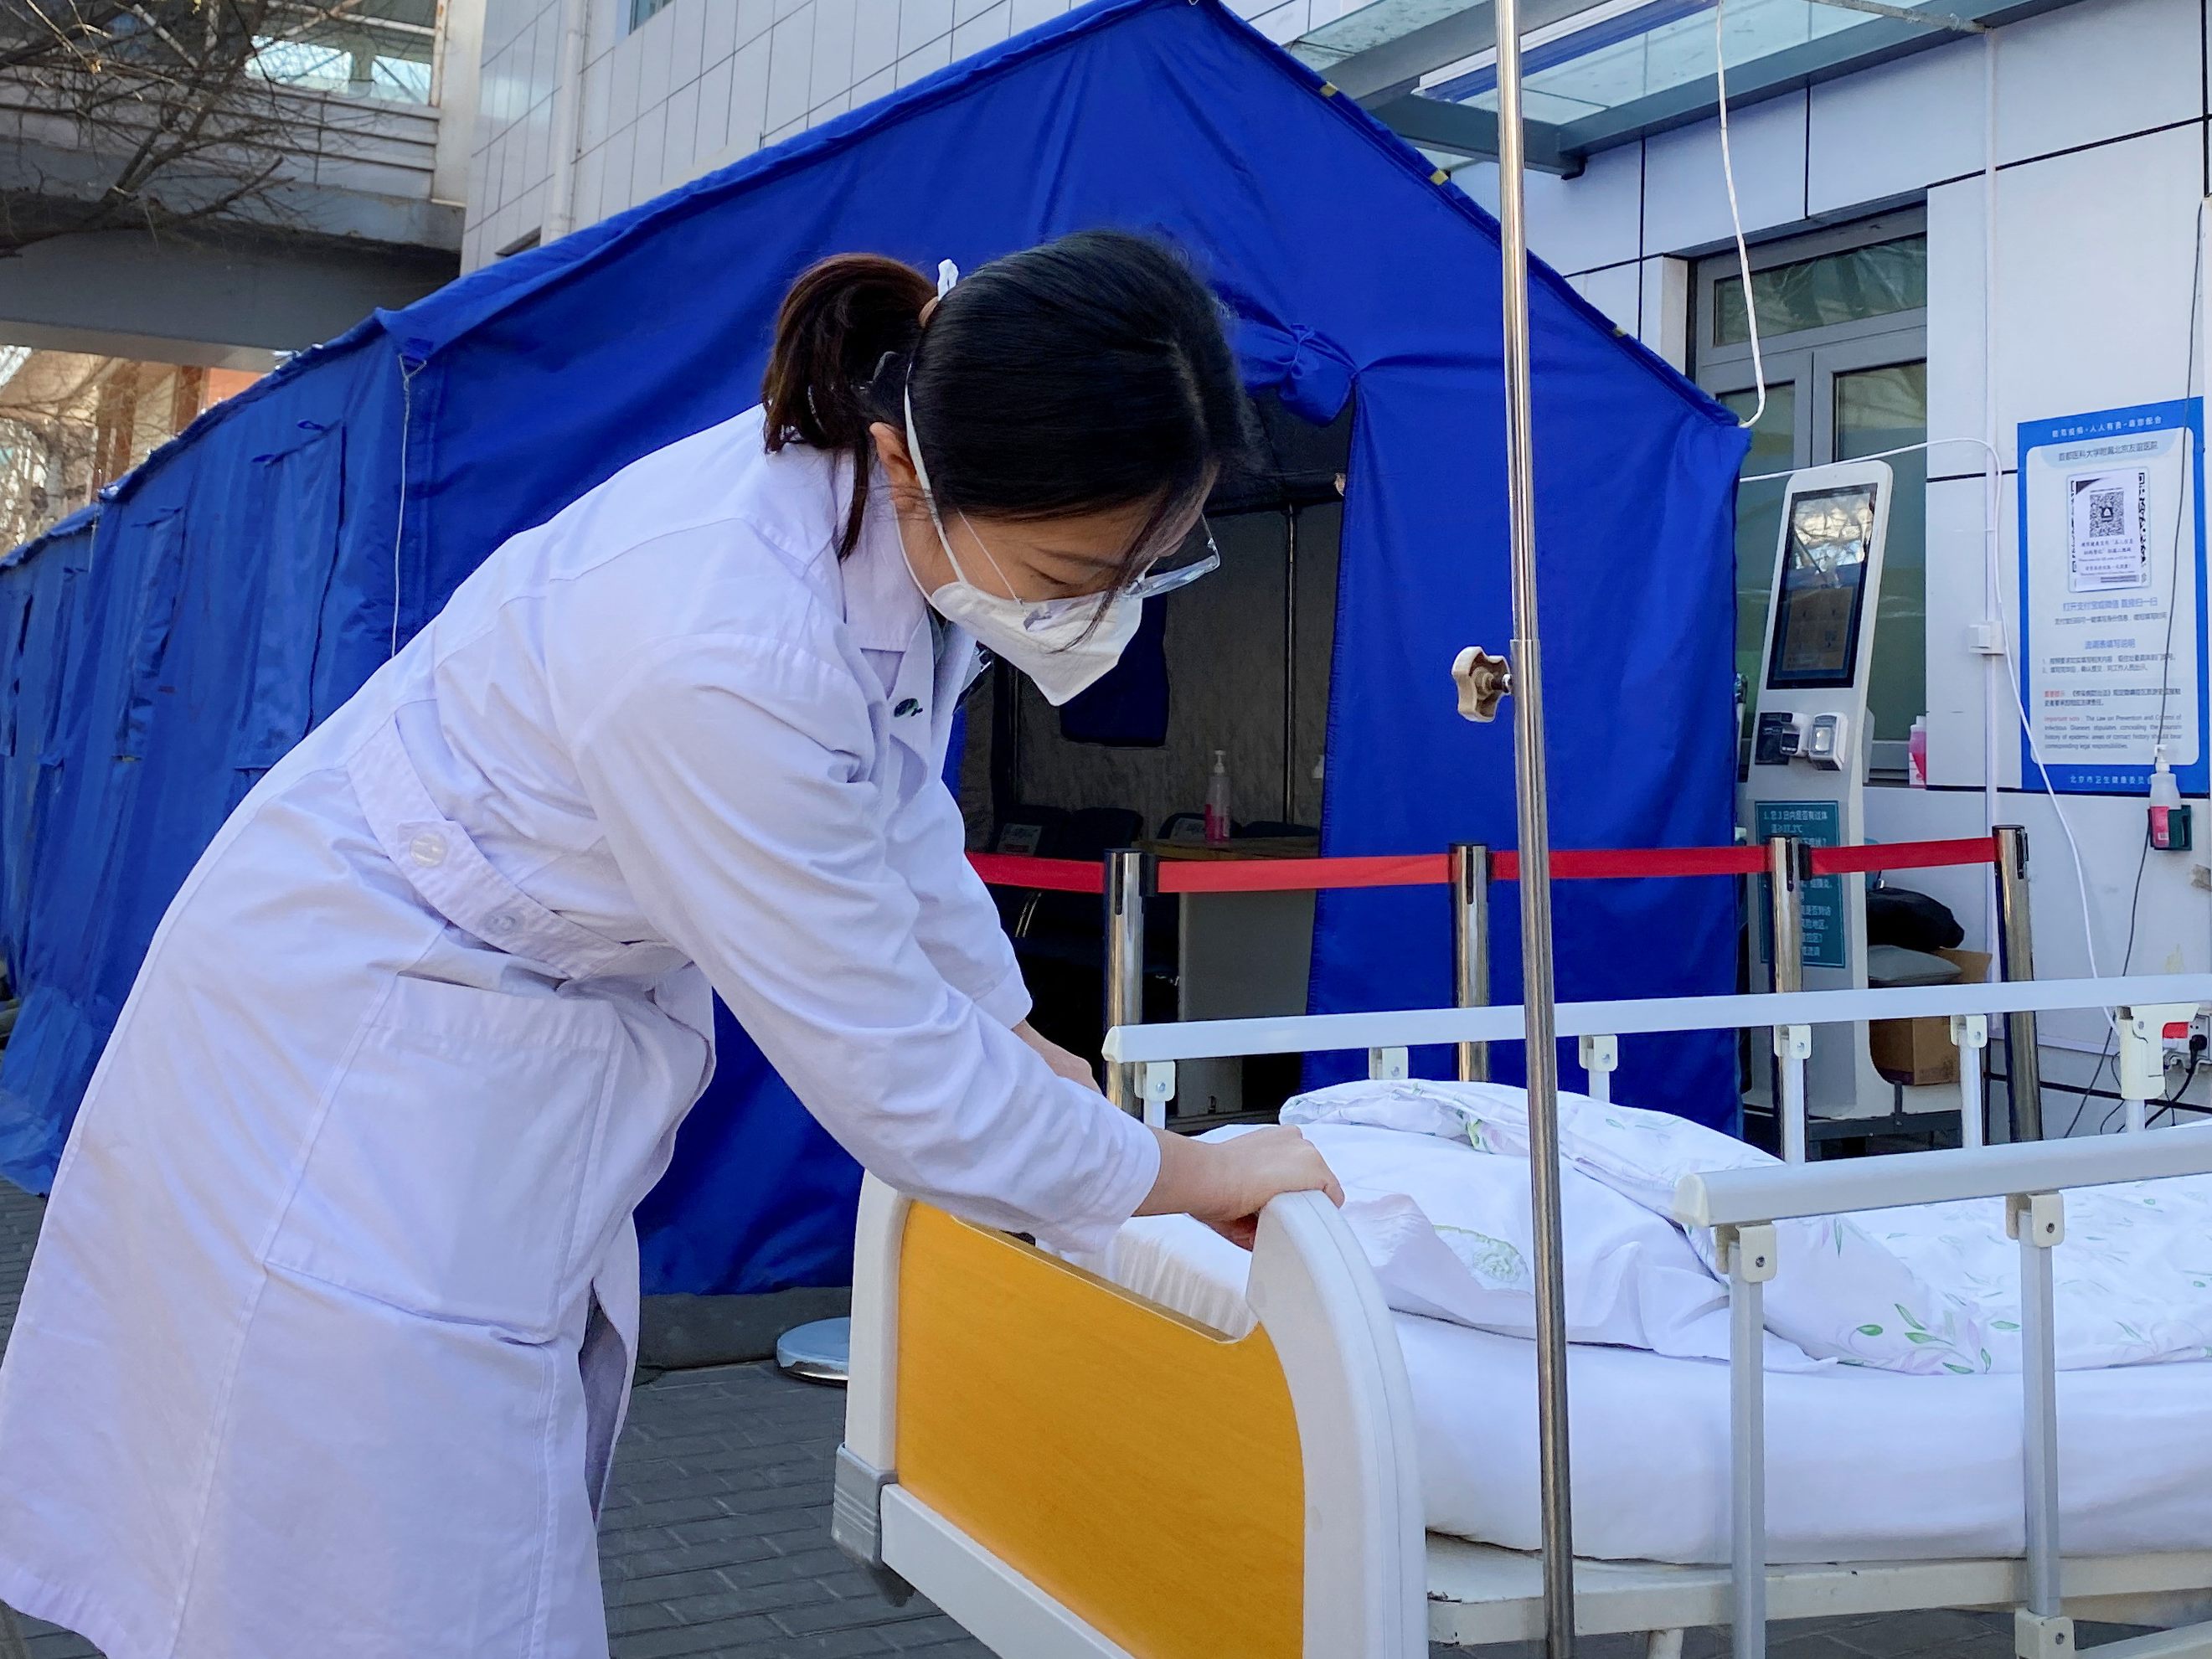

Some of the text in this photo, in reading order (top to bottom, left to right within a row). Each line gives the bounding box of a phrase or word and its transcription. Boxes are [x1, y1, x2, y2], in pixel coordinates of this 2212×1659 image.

[2070, 775, 2151, 785] 北京市卫生健康委员
